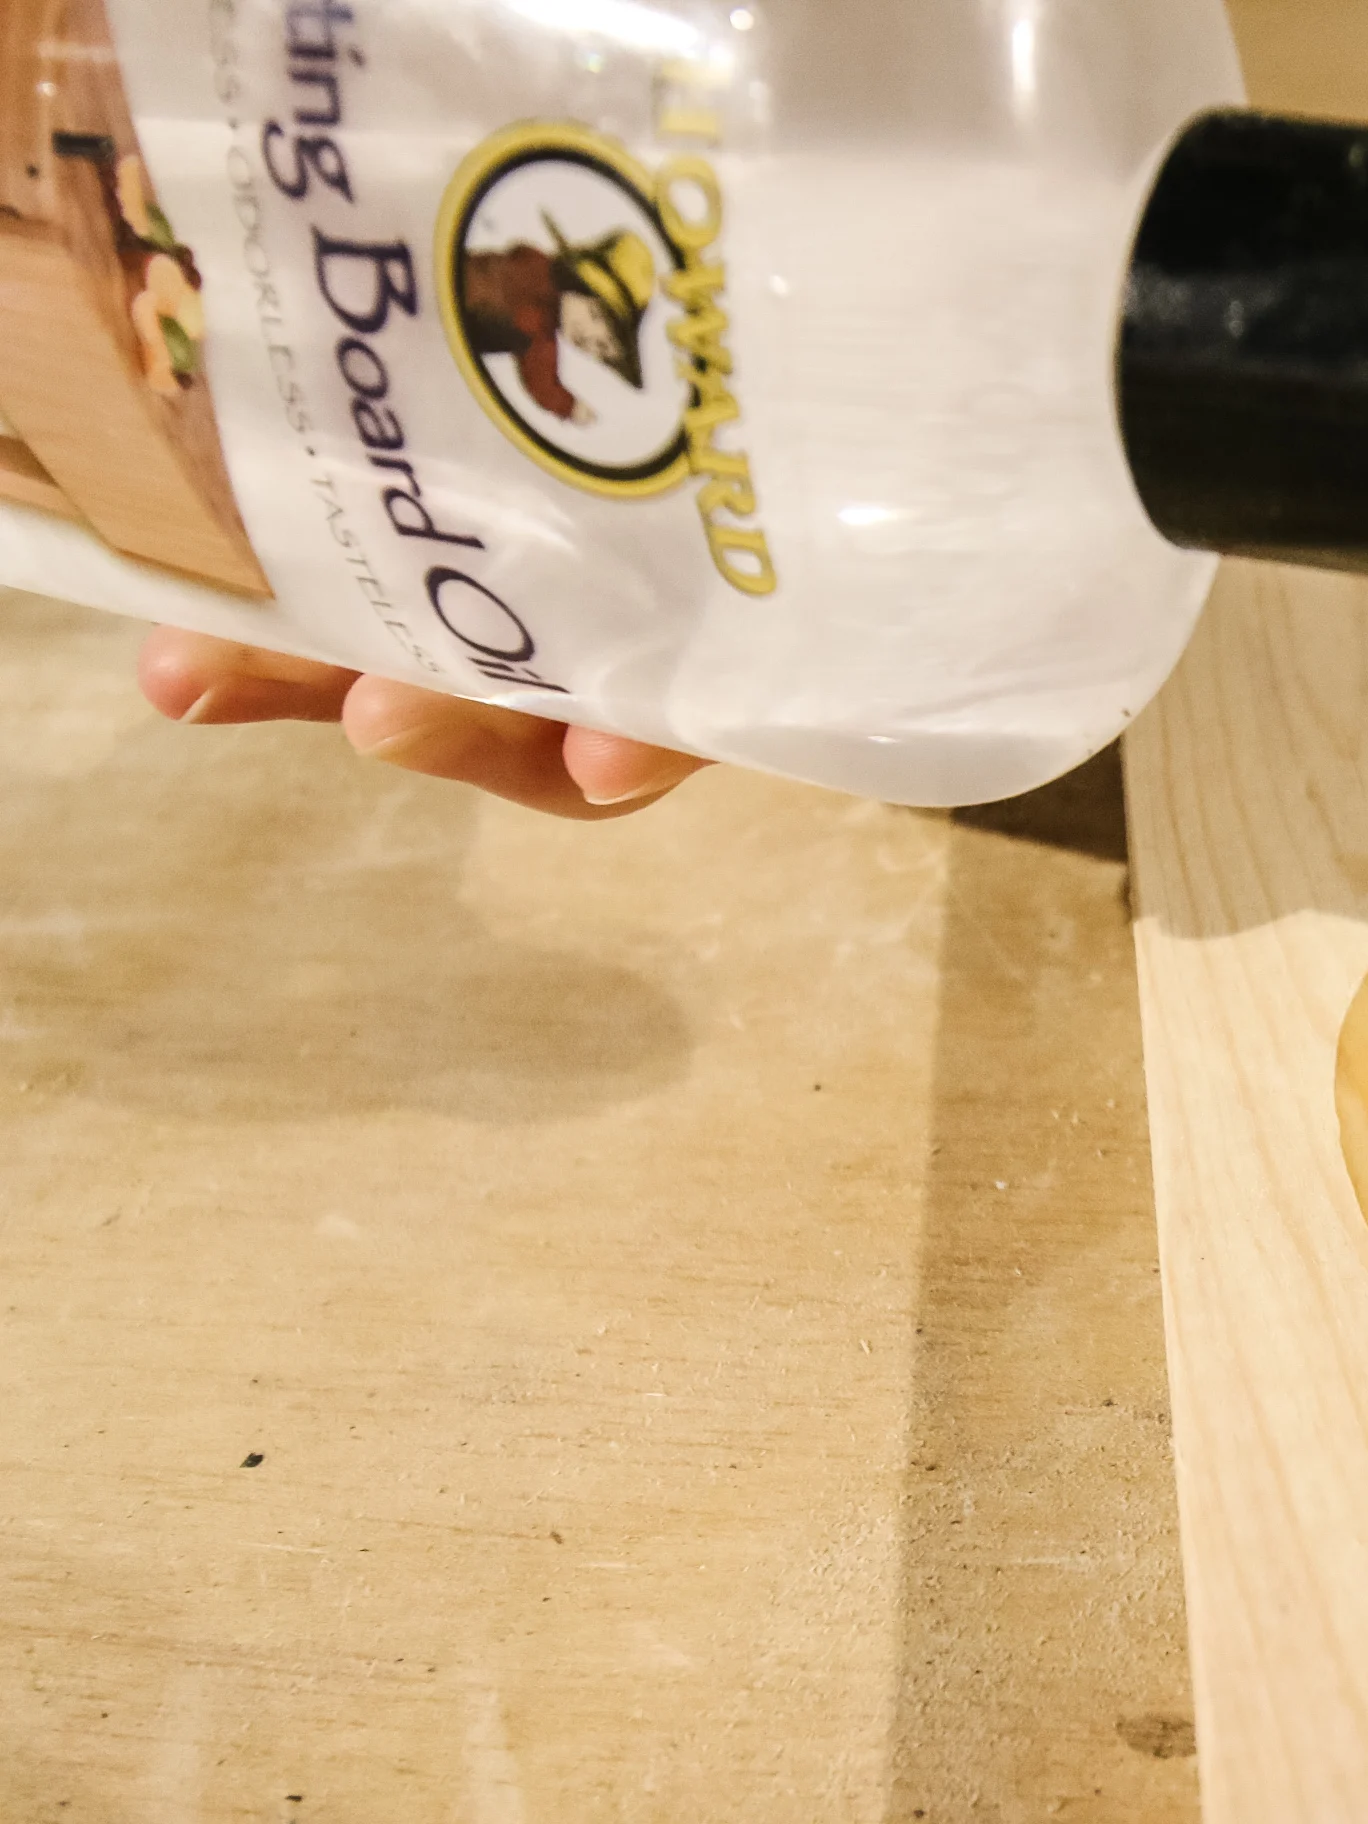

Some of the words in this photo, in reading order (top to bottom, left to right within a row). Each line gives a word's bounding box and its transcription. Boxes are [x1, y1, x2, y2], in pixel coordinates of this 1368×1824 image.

[226, 146, 315, 435] ODORLESS
[309, 472, 445, 675] TASTELESS
[310, 223, 486, 549] Board
[424, 565, 572, 694] Oil
[654, 57, 778, 597] HOWARD
